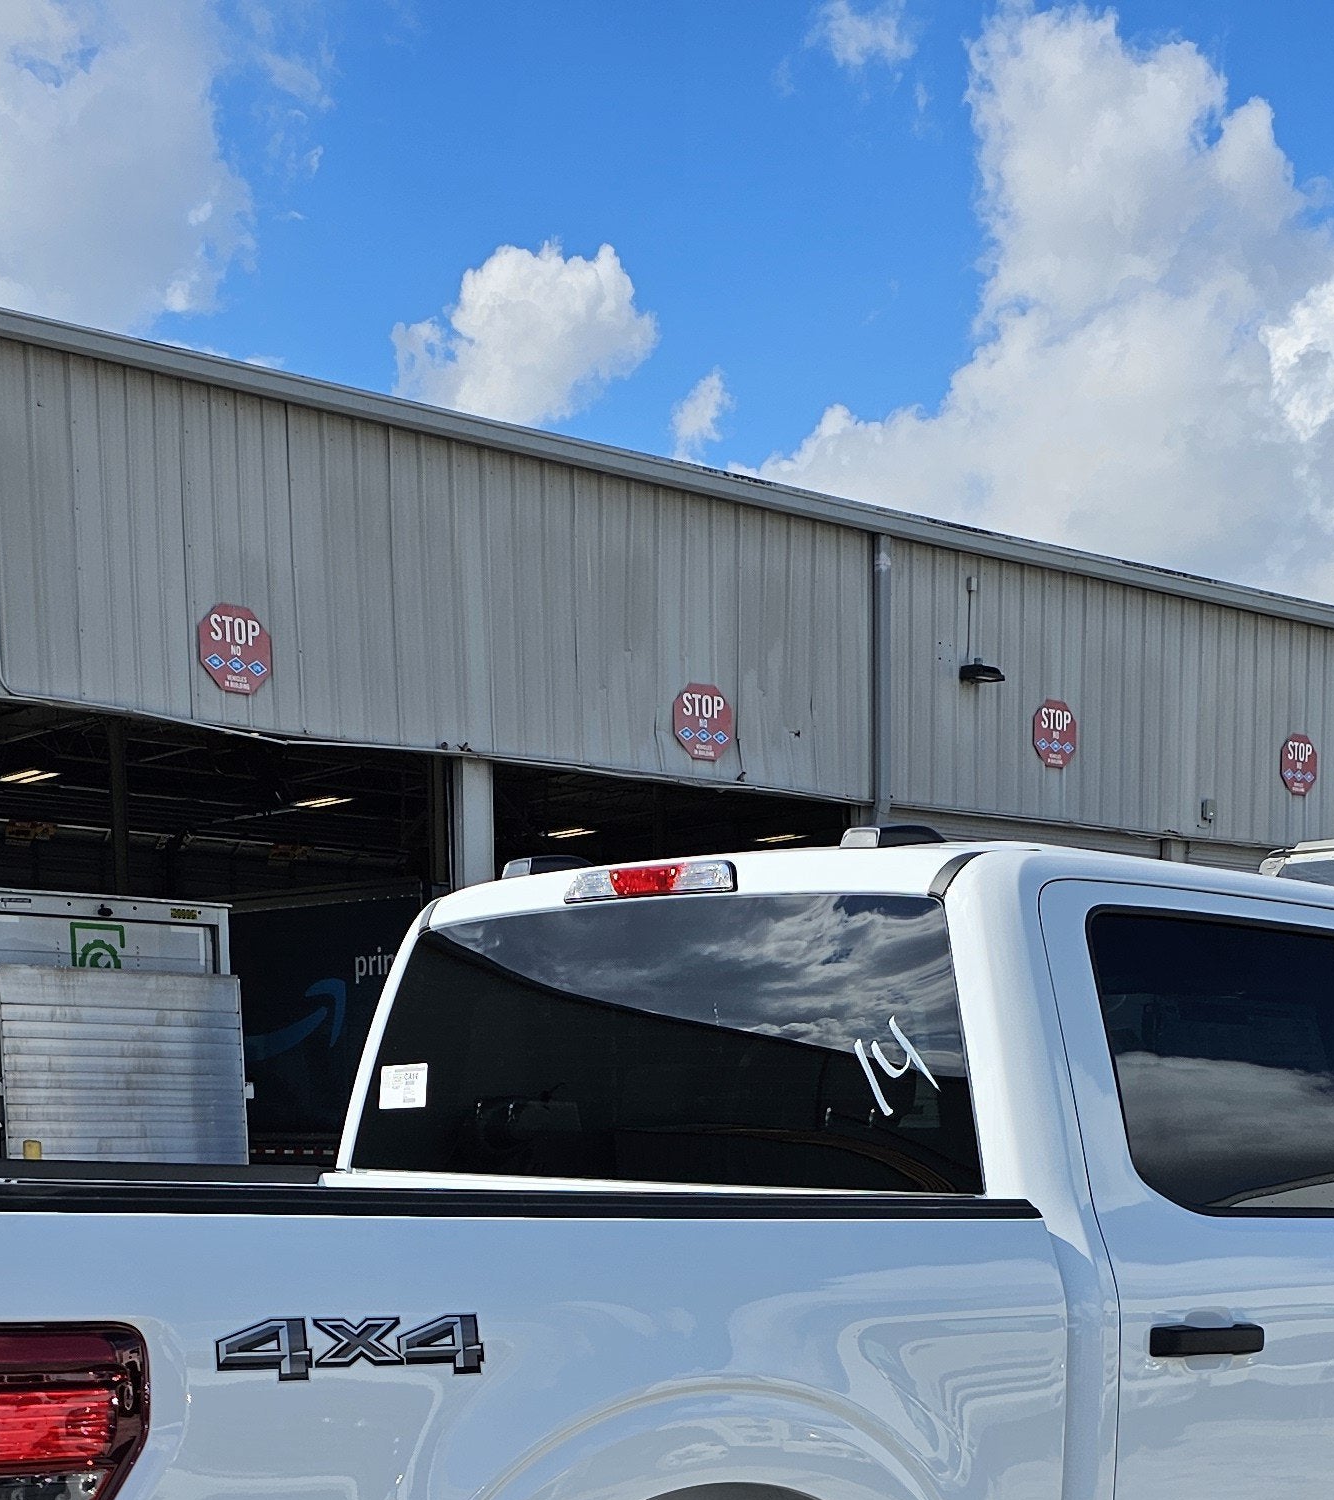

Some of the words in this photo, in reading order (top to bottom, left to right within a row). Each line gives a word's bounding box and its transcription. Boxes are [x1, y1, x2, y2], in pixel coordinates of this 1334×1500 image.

[209, 613, 260, 646] STOP
[230, 644, 242, 656] NO
[682, 692, 725, 719] STOP
[1041, 707, 1072, 732] STOP
[1287, 740, 1313, 763] STOP
